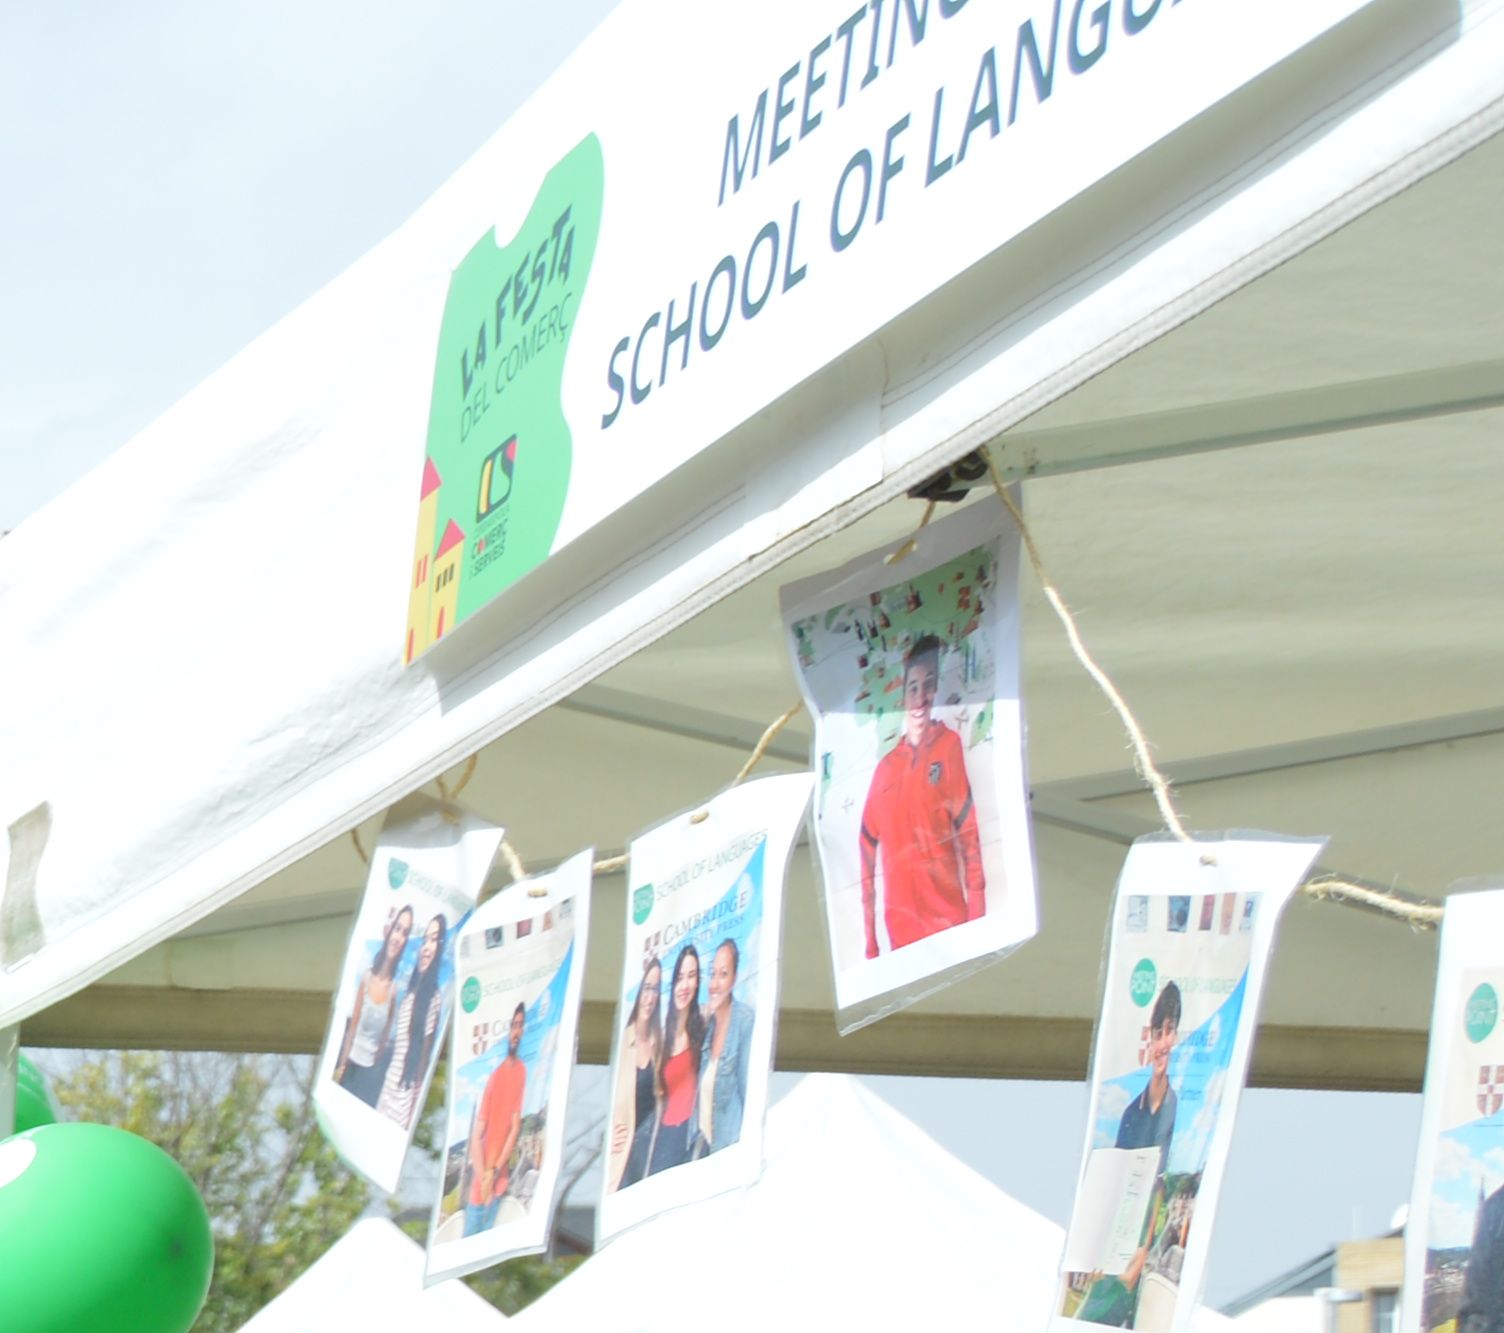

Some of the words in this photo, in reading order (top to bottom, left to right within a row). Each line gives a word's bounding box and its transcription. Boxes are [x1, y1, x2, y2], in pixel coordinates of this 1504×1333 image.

[460, 318, 487, 401] LA
[494, 203, 576, 350] FESTA
[600, 200, 808, 431] SCHOOL
[830, 112, 912, 254] OF
[923, 0, 1185, 188] LANG
[459, 388, 491, 444] DEL
[495, 292, 573, 395] COMERÇ
[662, 890, 749, 946] CAMBRIDGE
